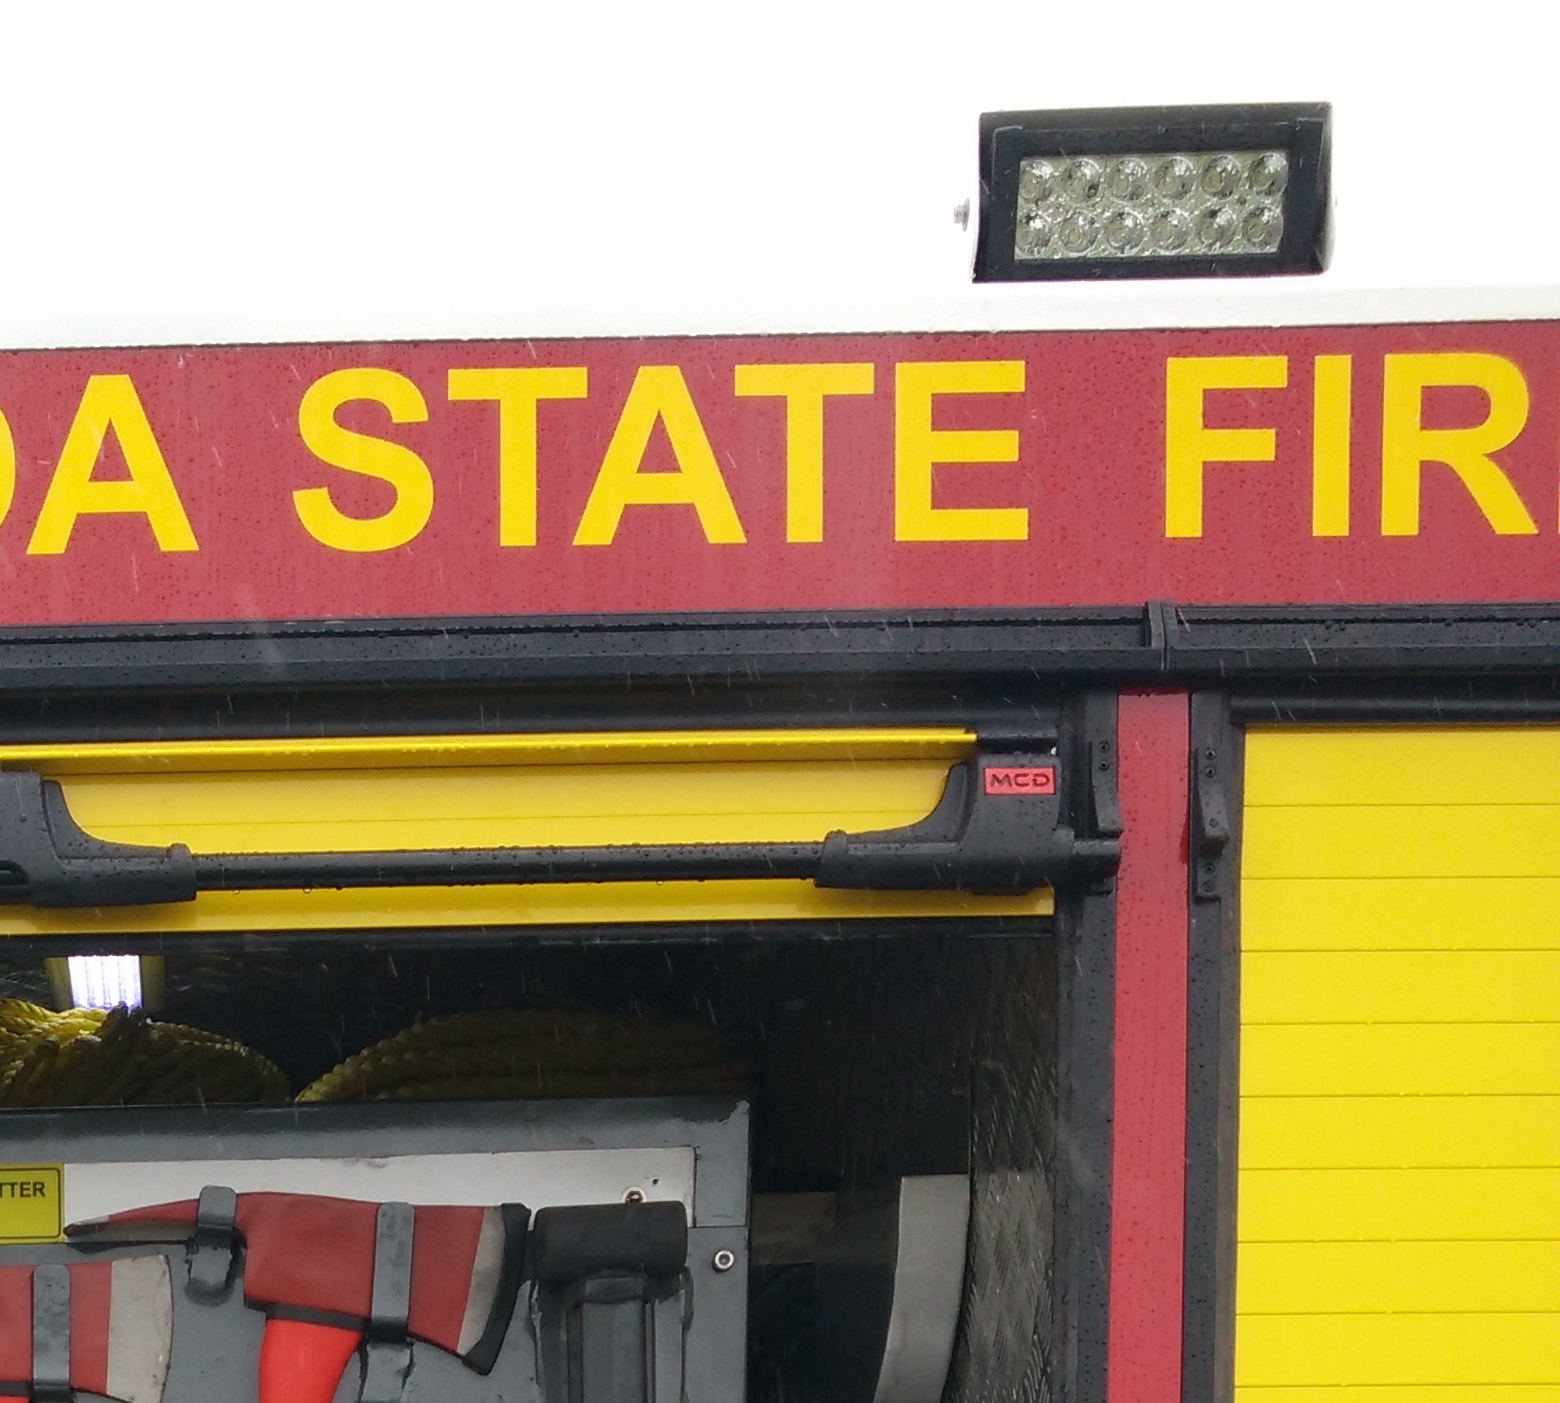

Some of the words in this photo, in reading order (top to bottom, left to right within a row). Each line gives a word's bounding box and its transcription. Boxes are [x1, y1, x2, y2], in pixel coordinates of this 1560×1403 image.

[292, 360, 1028, 552] STATE
[1165, 353, 1560, 537] FIR
[990, 773, 1049, 787] MCD
